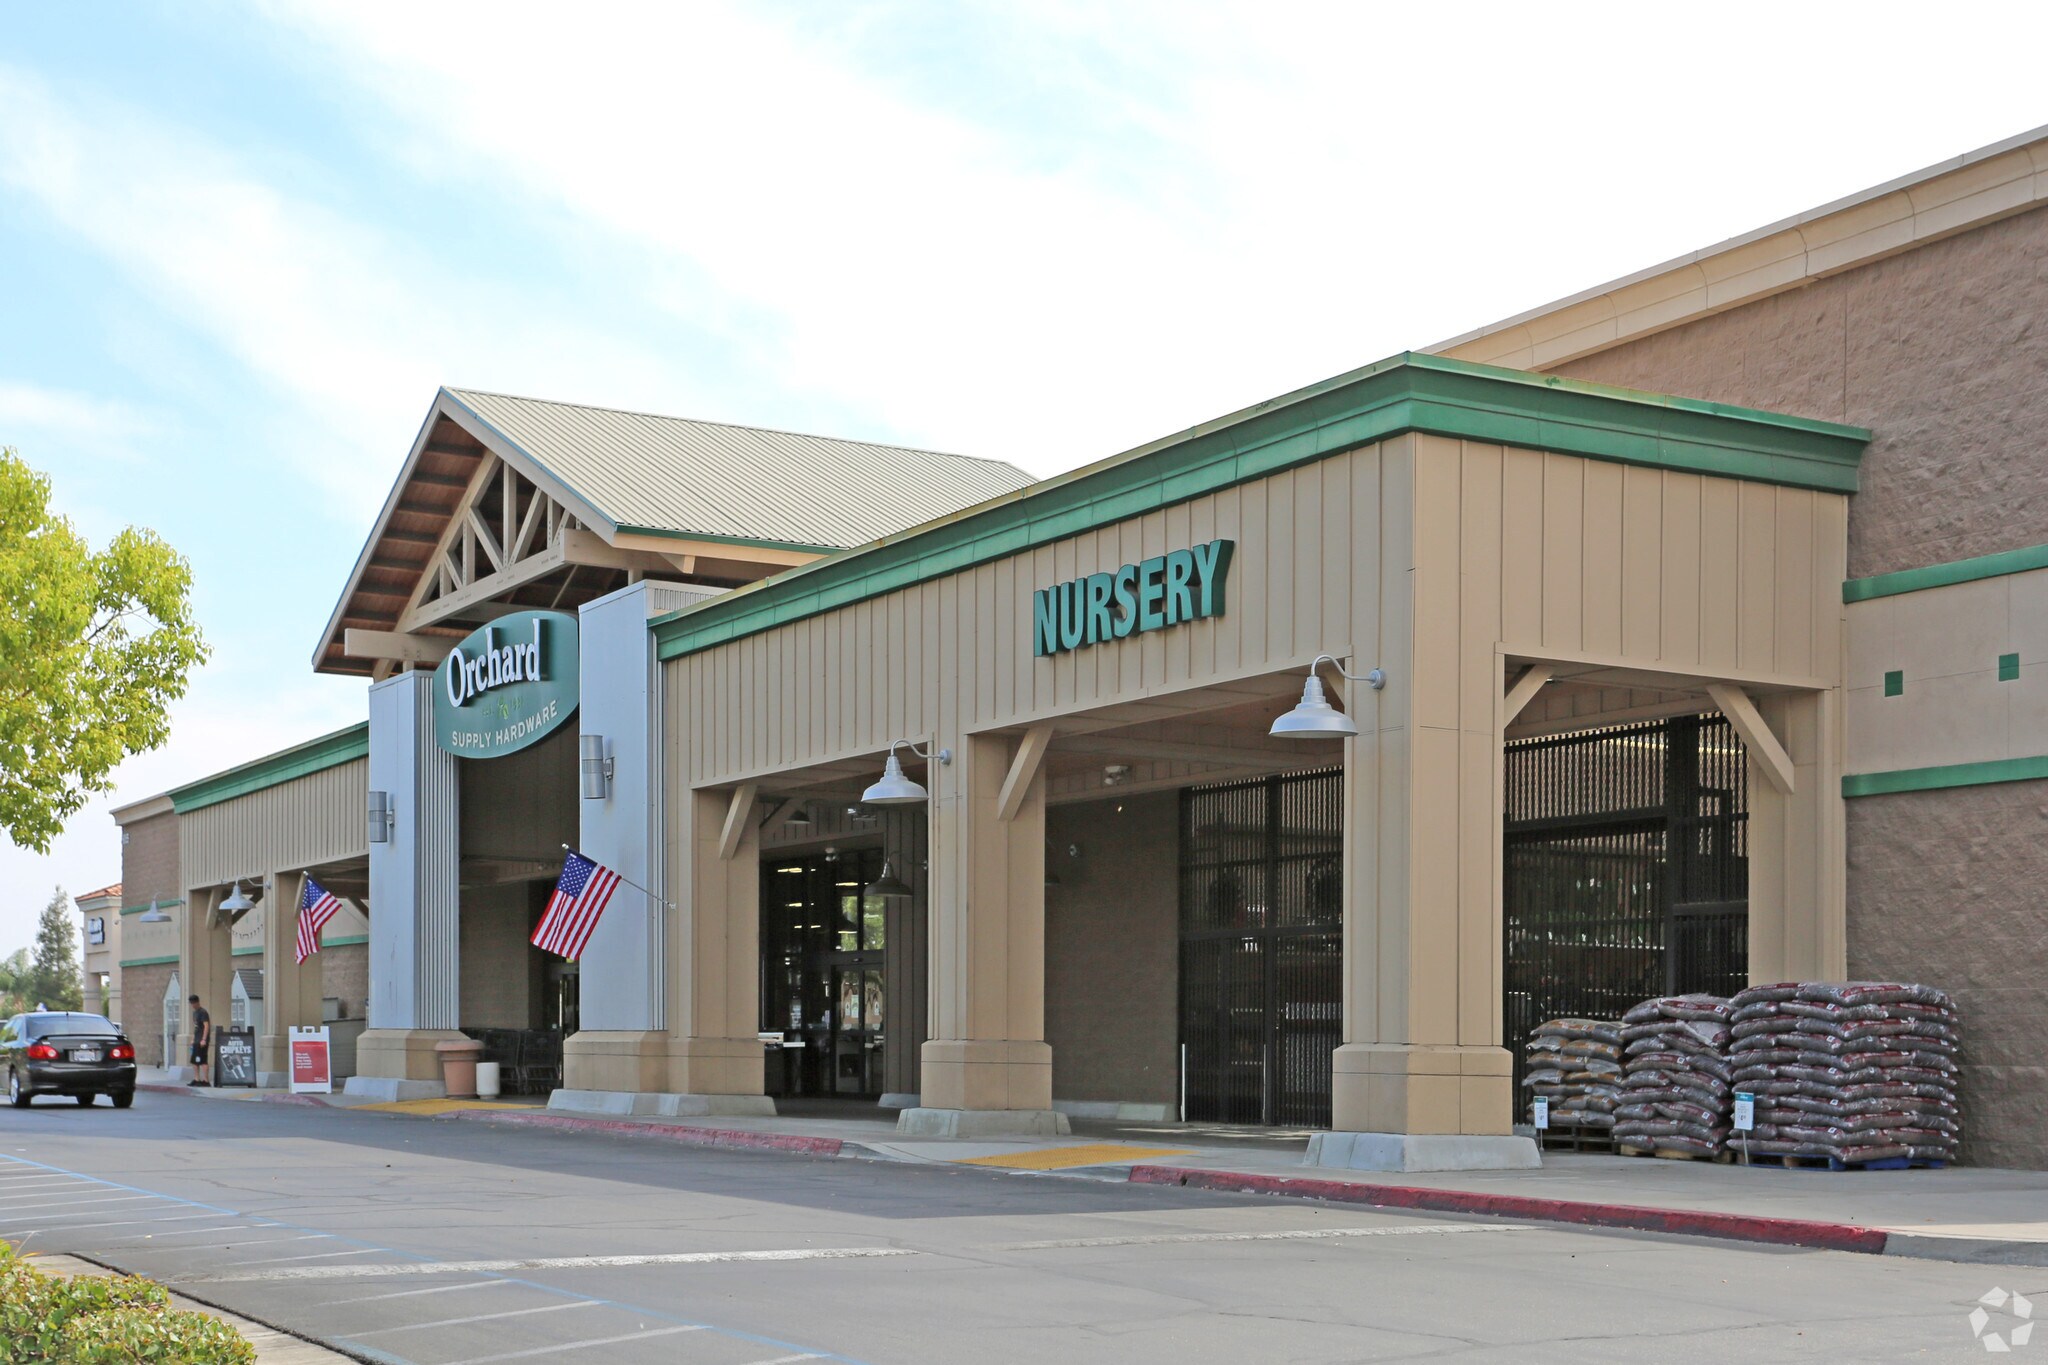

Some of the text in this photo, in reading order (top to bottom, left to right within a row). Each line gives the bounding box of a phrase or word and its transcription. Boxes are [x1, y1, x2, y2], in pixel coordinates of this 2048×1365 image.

[1034, 539, 1234, 657] NURSERY
[446, 618, 541, 708] Orchard
[452, 730, 491, 749] SUPPLY
[495, 699, 558, 745] HARDWARE
